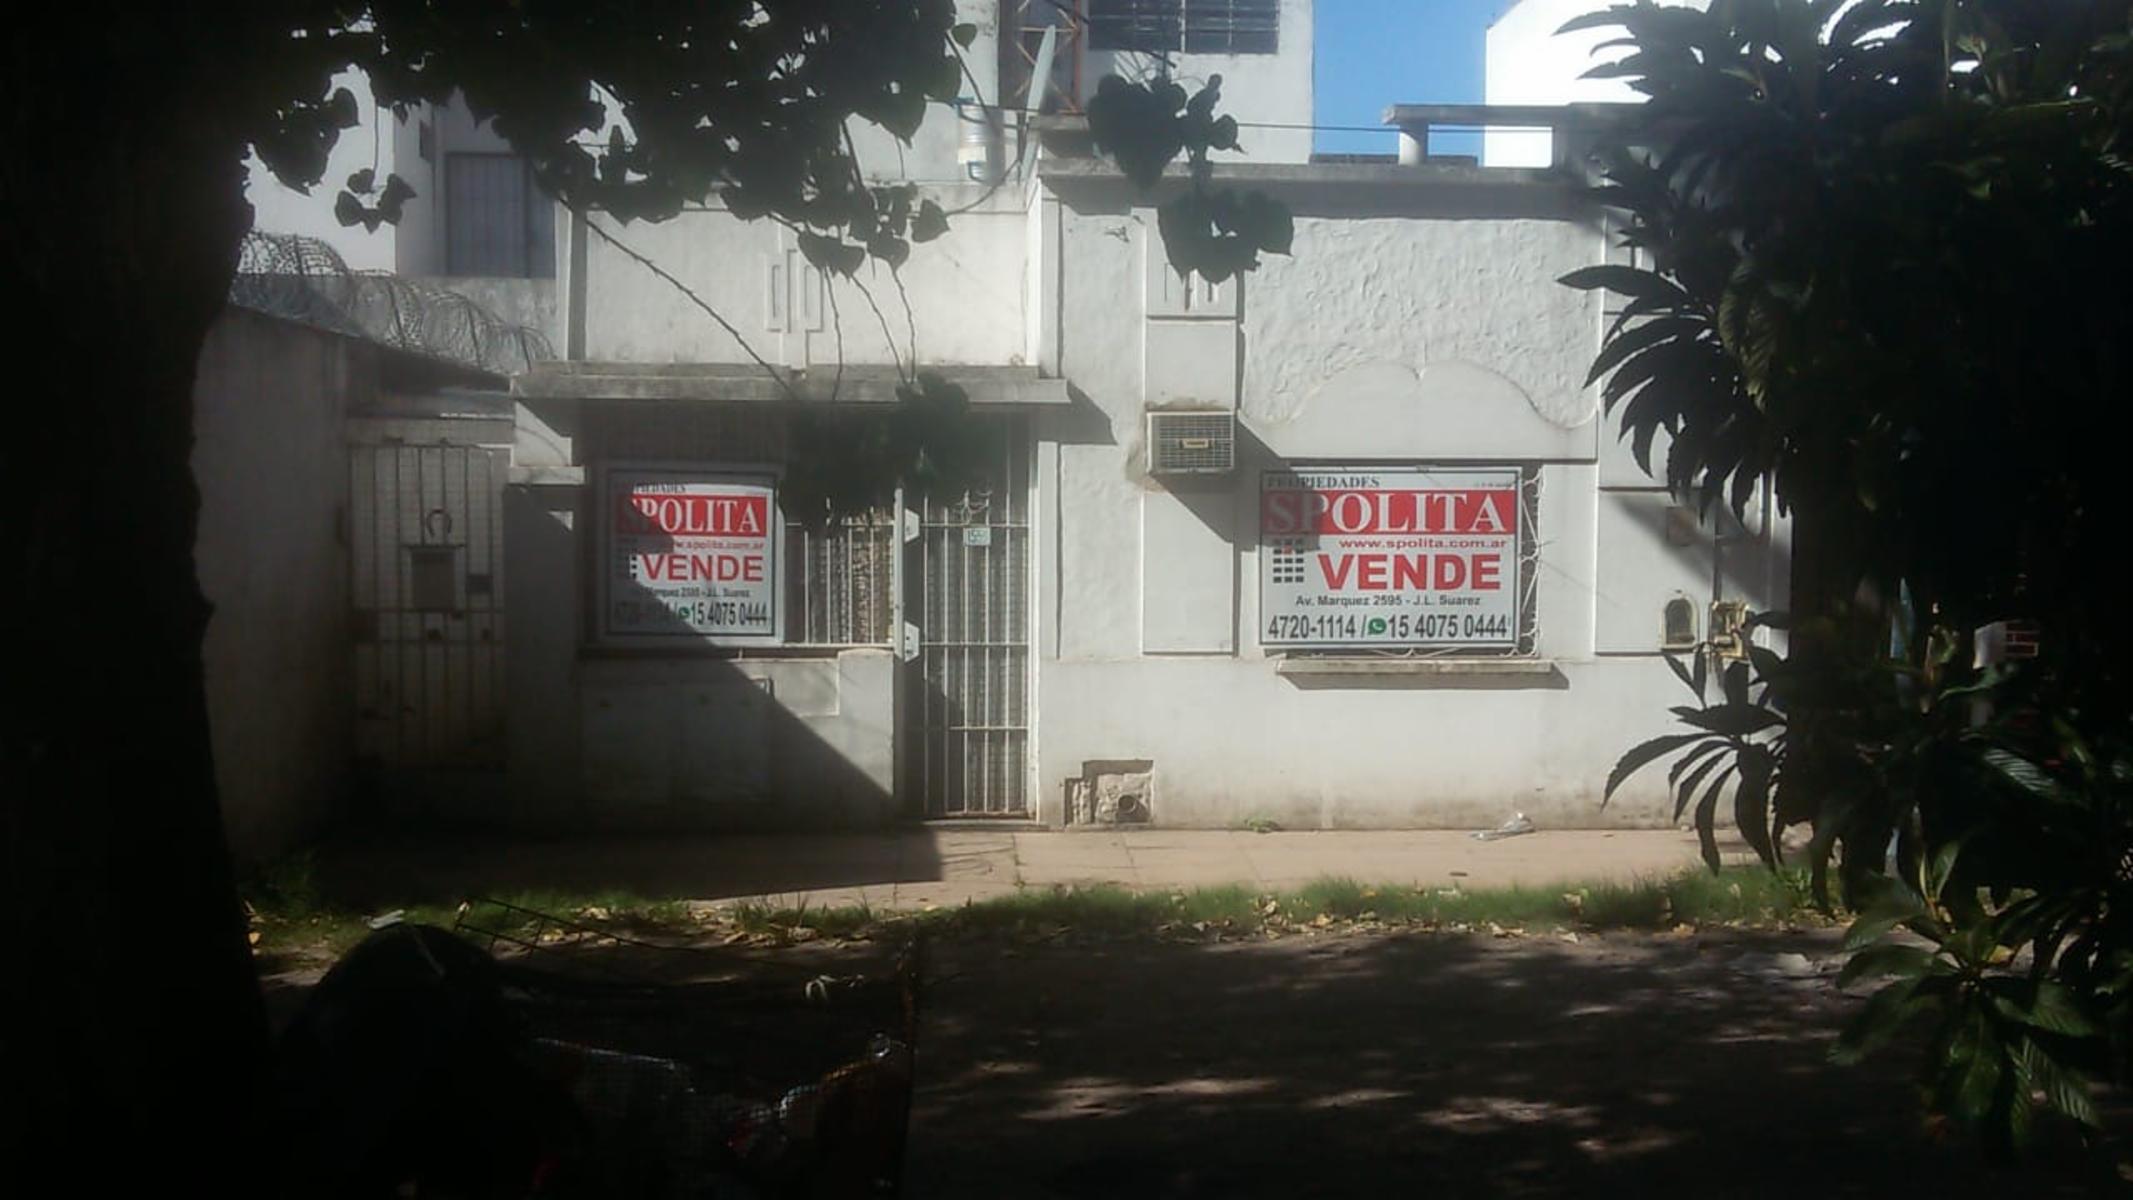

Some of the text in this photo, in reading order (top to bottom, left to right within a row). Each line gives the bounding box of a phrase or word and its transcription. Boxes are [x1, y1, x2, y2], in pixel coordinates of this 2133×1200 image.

[1268, 492, 1507, 533] SPOLITA
[1339, 538, 1507, 550] www.spolita.com.ar
[641, 555, 763, 582] VENDE
[1317, 554, 1501, 590] VENDE
[690, 602, 705, 625] 15
[707, 602, 736, 626] 4075
[739, 602, 767, 626] 0444
[1295, 596, 1315, 606] Av.
[1318, 596, 1369, 608] Marquez
[1373, 596, 1402, 606] 2595
[1439, 596, 1481, 606] Suarez
[1268, 615, 1356, 639] 4720-1114
[1388, 616, 1409, 638] 15
[1414, 615, 1459, 639] 4075
[1464, 615, 1507, 639] 0444
